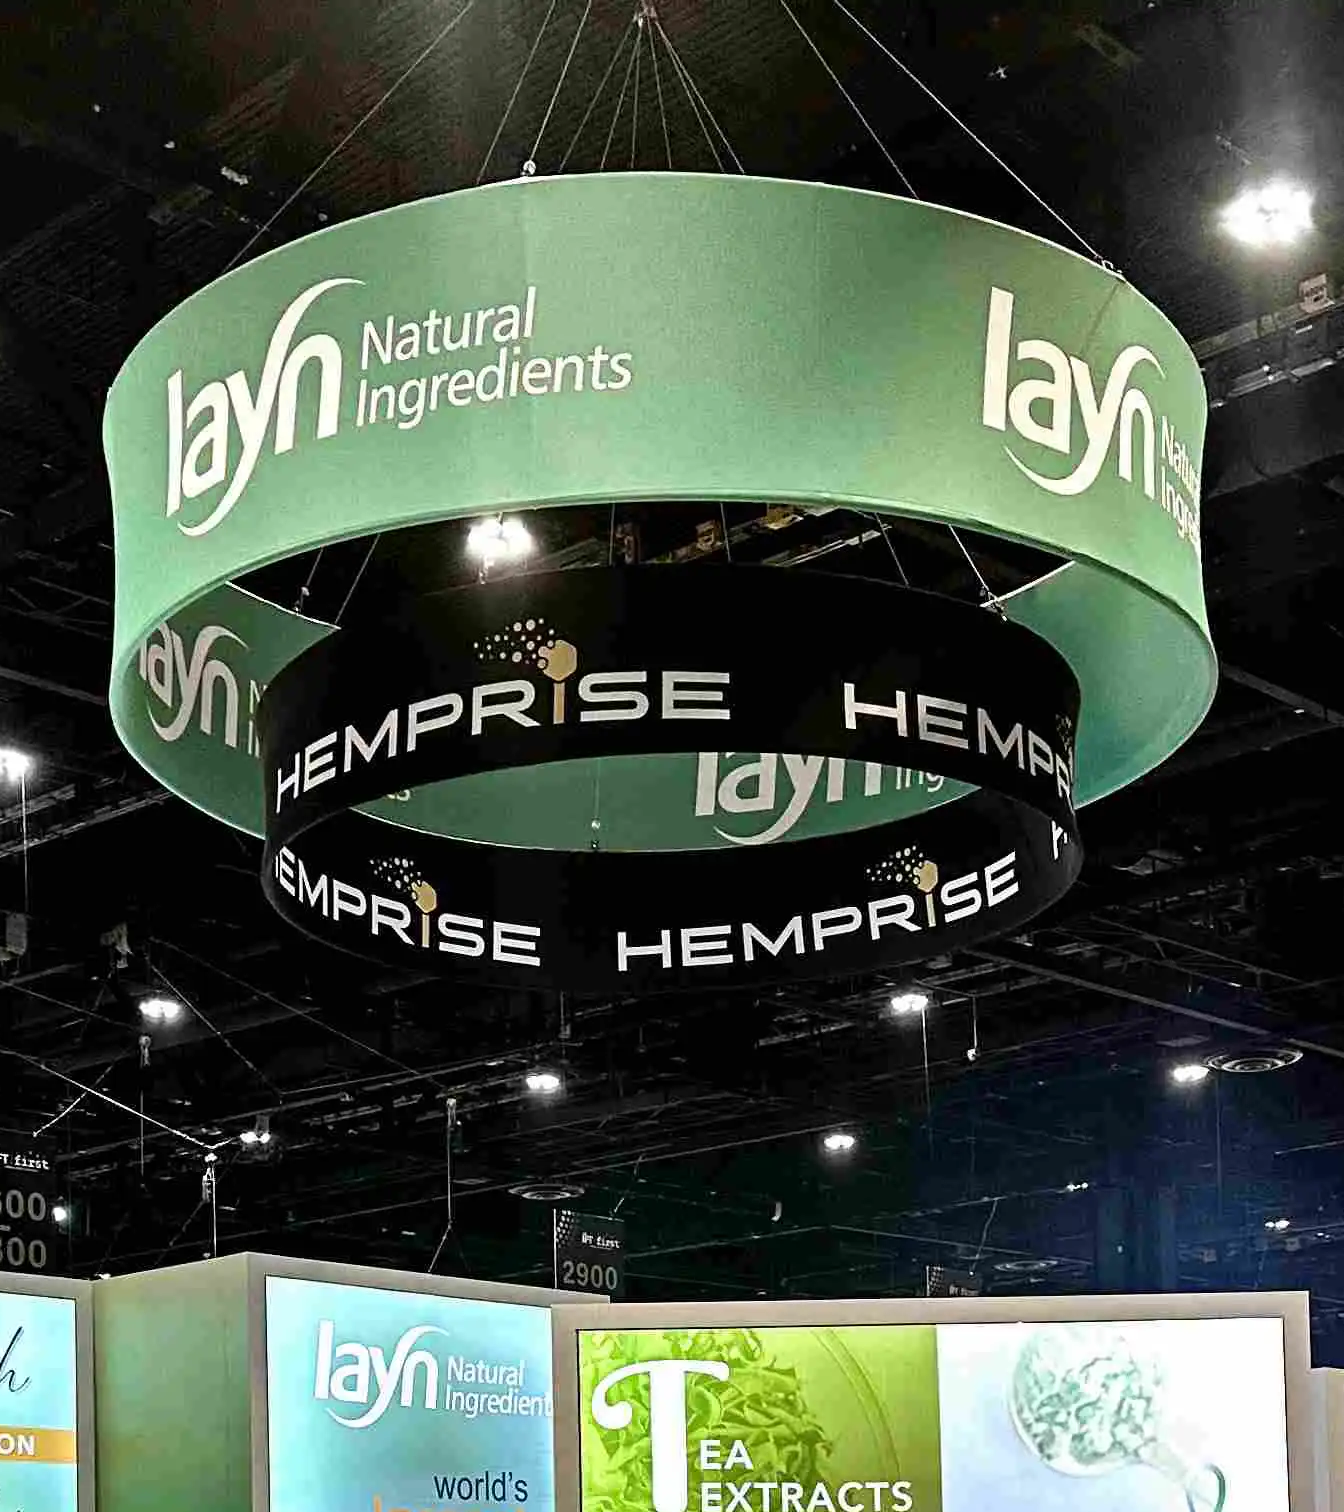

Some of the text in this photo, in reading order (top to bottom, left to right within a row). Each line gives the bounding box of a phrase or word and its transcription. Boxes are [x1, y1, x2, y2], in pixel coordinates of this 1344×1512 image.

[166, 278, 537, 536] layn Natural
[356, 344, 633, 430] Ingredients
[983, 286, 1166, 496] layn
[276, 665, 730, 814] HEMPRISE
[617, 851, 1019, 972] HEMPRISE
[563, 1260, 617, 1290] 2900
[314, 1319, 525, 1429] layn Natural
